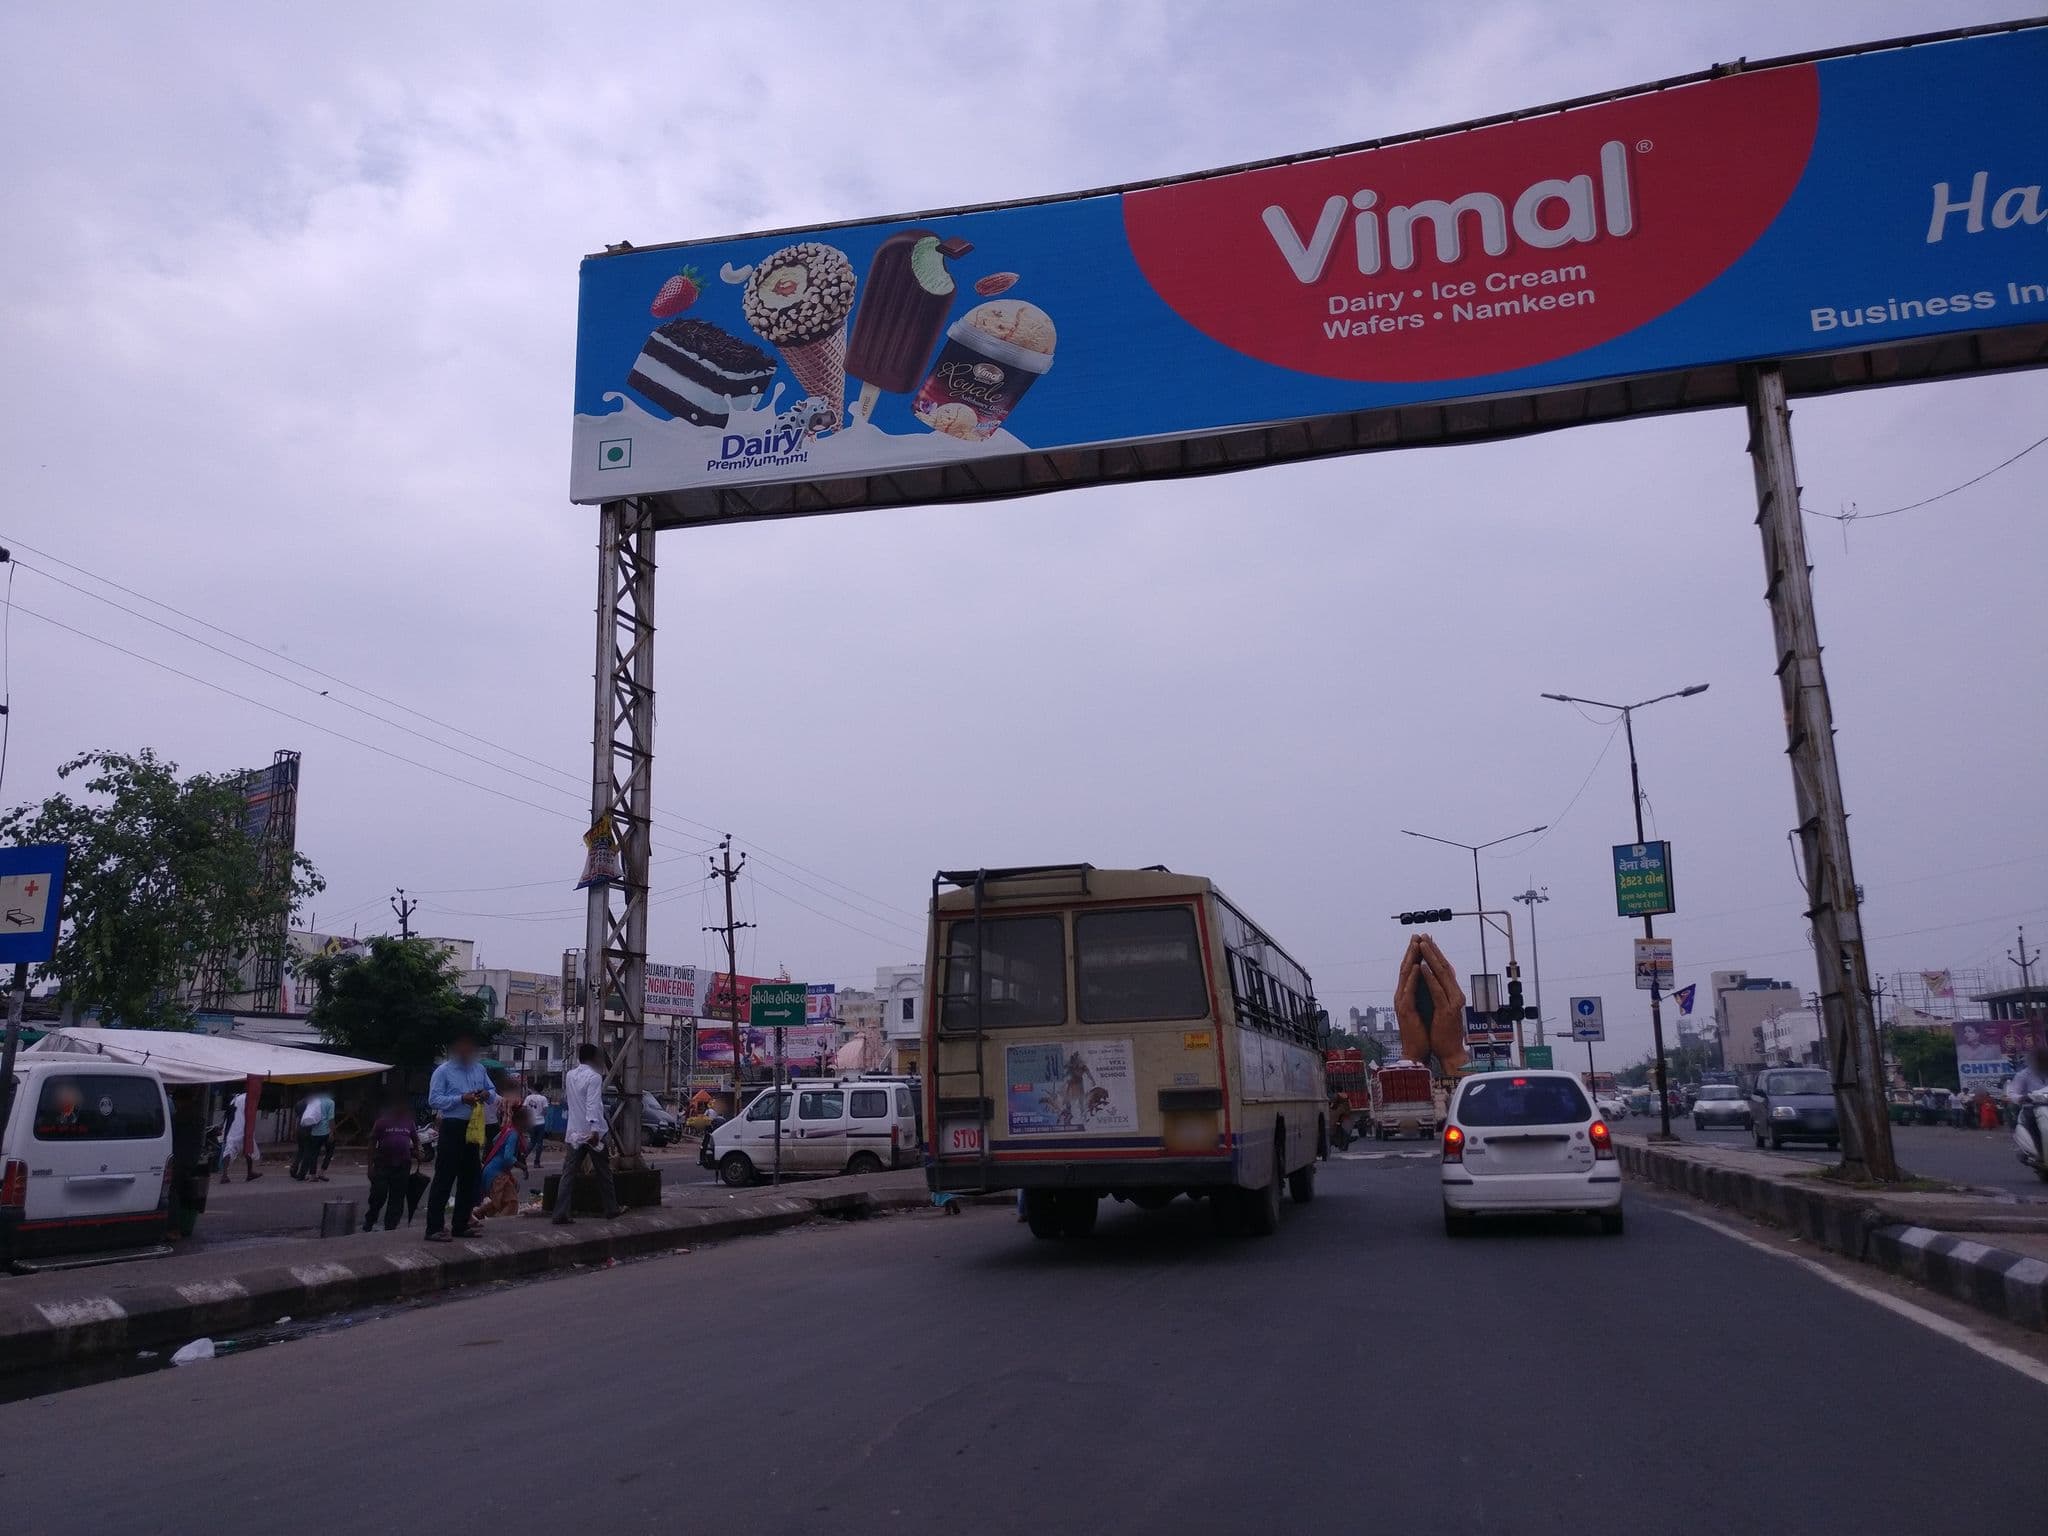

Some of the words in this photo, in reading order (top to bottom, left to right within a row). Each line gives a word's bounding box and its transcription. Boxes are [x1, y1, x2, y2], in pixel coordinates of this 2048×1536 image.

[1261, 140, 1633, 284] Vimal
[1926, 171, 2048, 244] Ha
[1322, 312, 1426, 340] Wafers
[1452, 288, 1596, 323] Namkeen
[1328, 292, 1404, 315] Dairy
[1431, 281, 1477, 301] Ice
[1485, 264, 1587, 293] Cream
[1810, 290, 1997, 332] Business
[2007, 282, 2048, 305] In
[721, 428, 803, 460] Dairy
[674, 967, 695, 981] POWER
[646, 994, 671, 1005] RESEARCH
